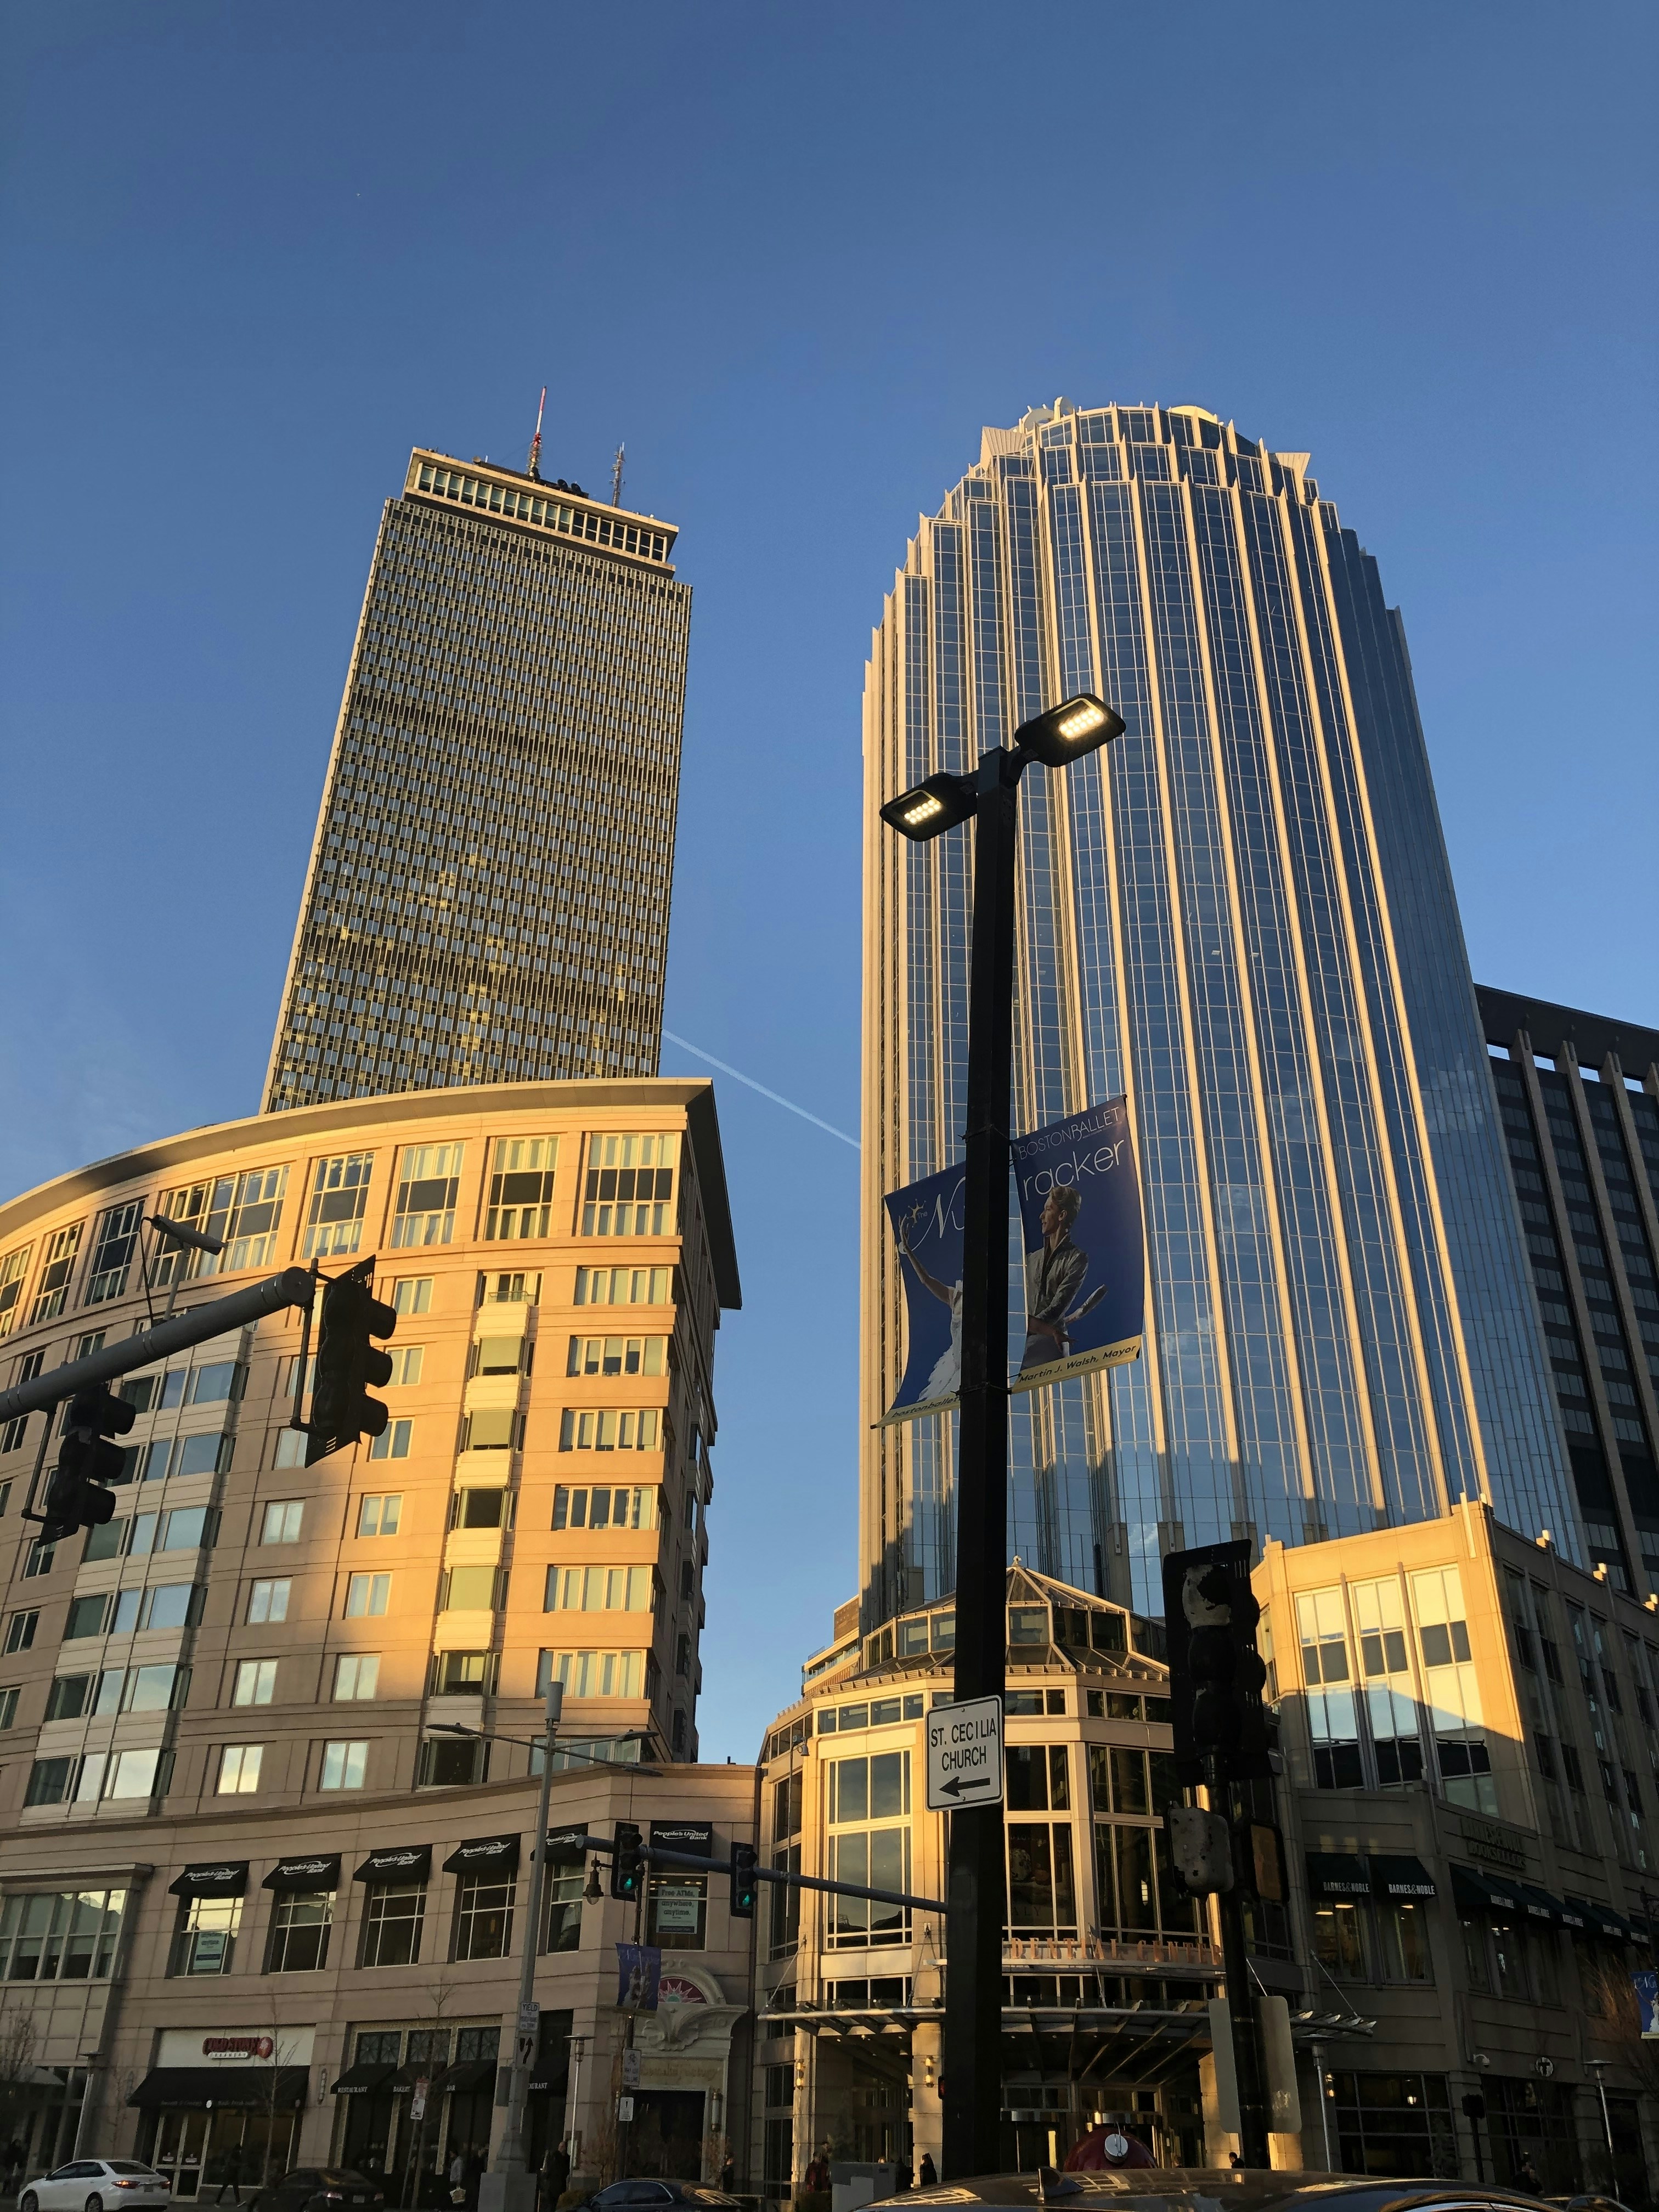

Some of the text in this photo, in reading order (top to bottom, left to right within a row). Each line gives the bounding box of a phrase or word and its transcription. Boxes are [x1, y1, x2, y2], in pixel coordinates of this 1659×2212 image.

[899, 1176, 966, 1255] Nu
[916, 1211, 928, 1219] The
[1019, 1345, 1136, 1383] Martin J. Walsh, Mayor
[930, 1718, 997, 1748] ST. CECILIA
[941, 1745, 987, 1771] CHURCH
[1323, 1882, 1370, 1893] BARNES&NOBLE
[1388, 1883, 1435, 1895] BARNES&NOBLE
[1002, 1937, 1123, 1961] DENTIAL
